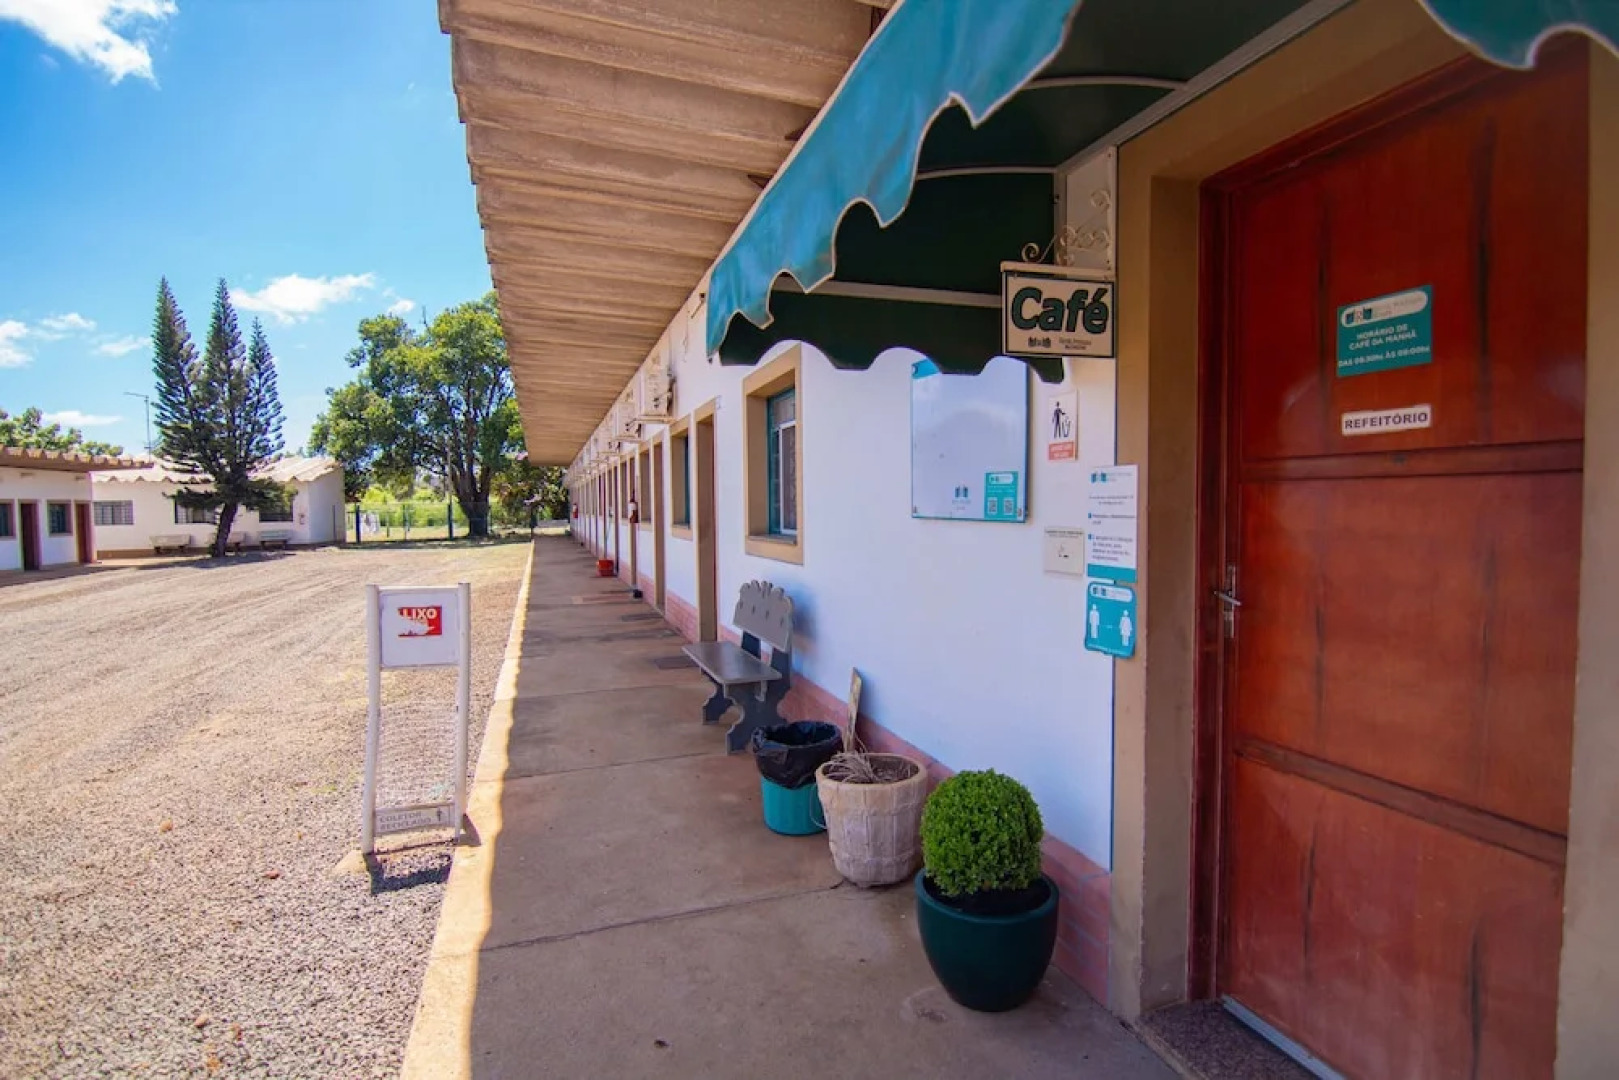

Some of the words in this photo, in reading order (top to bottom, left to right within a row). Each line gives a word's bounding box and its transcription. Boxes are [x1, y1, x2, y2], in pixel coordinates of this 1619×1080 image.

[1012, 287, 1109, 334] Café
[1349, 339, 1371, 350] CAFÉ
[1371, 337, 1384, 346] DA
[1385, 329, 1417, 343] MANHÃ
[1356, 326, 1395, 340] HORÁRIO
[1396, 323, 1409, 333] DE
[1344, 412, 1429, 429] REFEITÓRIO
[403, 608, 437, 619] LIXO
[379, 811, 422, 823] COLETOR
